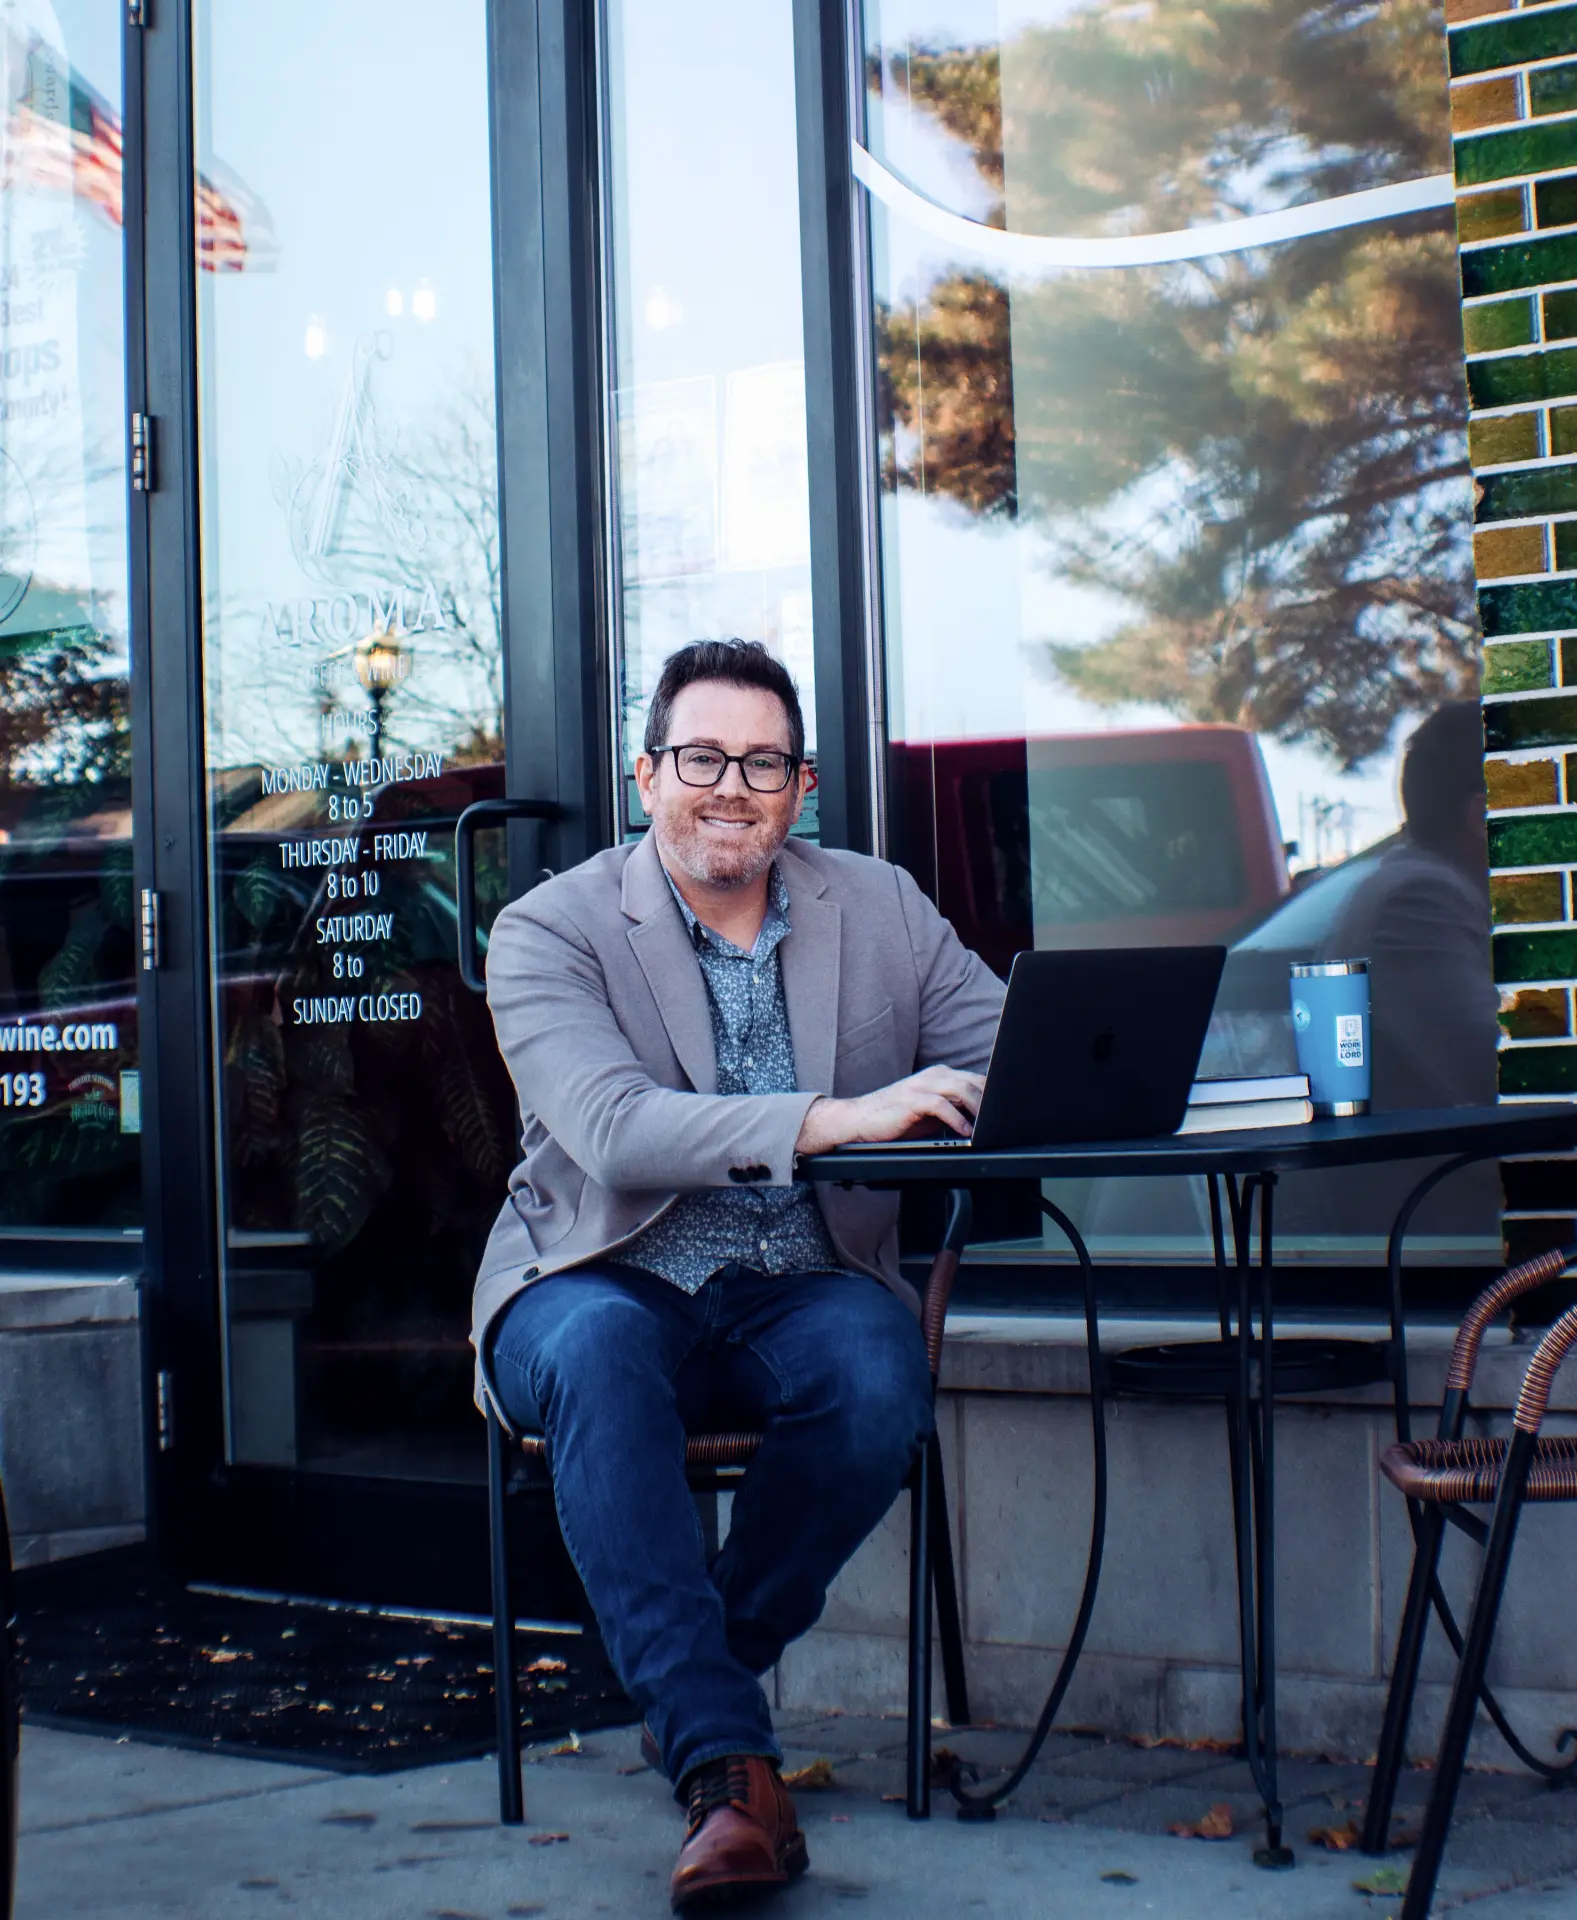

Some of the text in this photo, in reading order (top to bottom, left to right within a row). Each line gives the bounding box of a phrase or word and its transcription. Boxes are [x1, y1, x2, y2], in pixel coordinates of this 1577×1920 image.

[0, 338, 61, 387] ops
[261, 577, 447, 649] AROMA
[321, 708, 379, 741] HOURS
[261, 763, 329, 795] MONDAY
[342, 752, 443, 786] WEDNESDAY
[328, 791, 374, 821] 8 to 5
[278, 837, 360, 869] THURSDAY
[374, 831, 428, 861] FRIDAY
[327, 870, 380, 899] 8 to 10
[316, 913, 393, 944] SATURDAY
[333, 952, 364, 978] 8 to
[293, 993, 421, 1025] SUNDAY CLOSED
[1340, 1051, 1362, 1059] LORD
